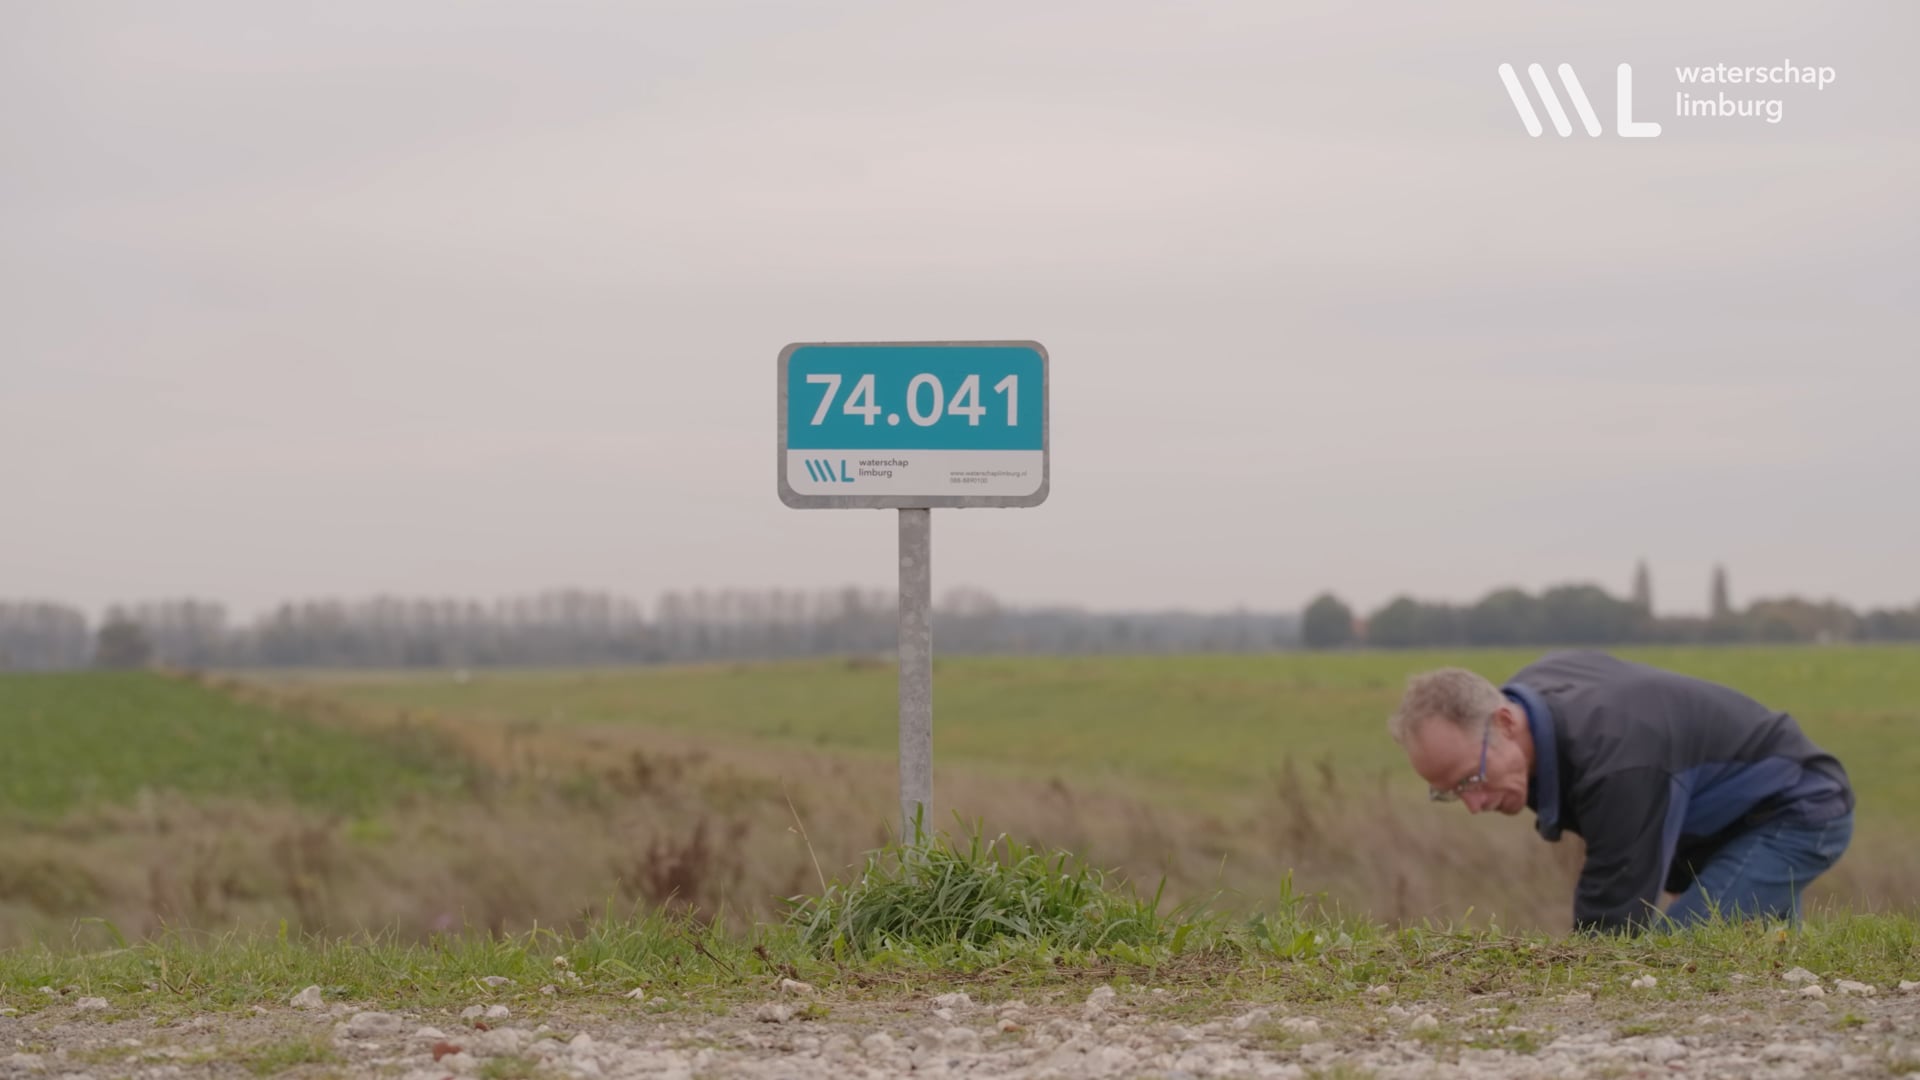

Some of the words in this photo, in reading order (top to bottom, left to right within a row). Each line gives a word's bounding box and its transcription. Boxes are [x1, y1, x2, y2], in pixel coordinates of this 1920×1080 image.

[806, 373, 1019, 427] 74.041
[858, 458, 909, 468] waterschap
[858, 468, 893, 479] limburg
